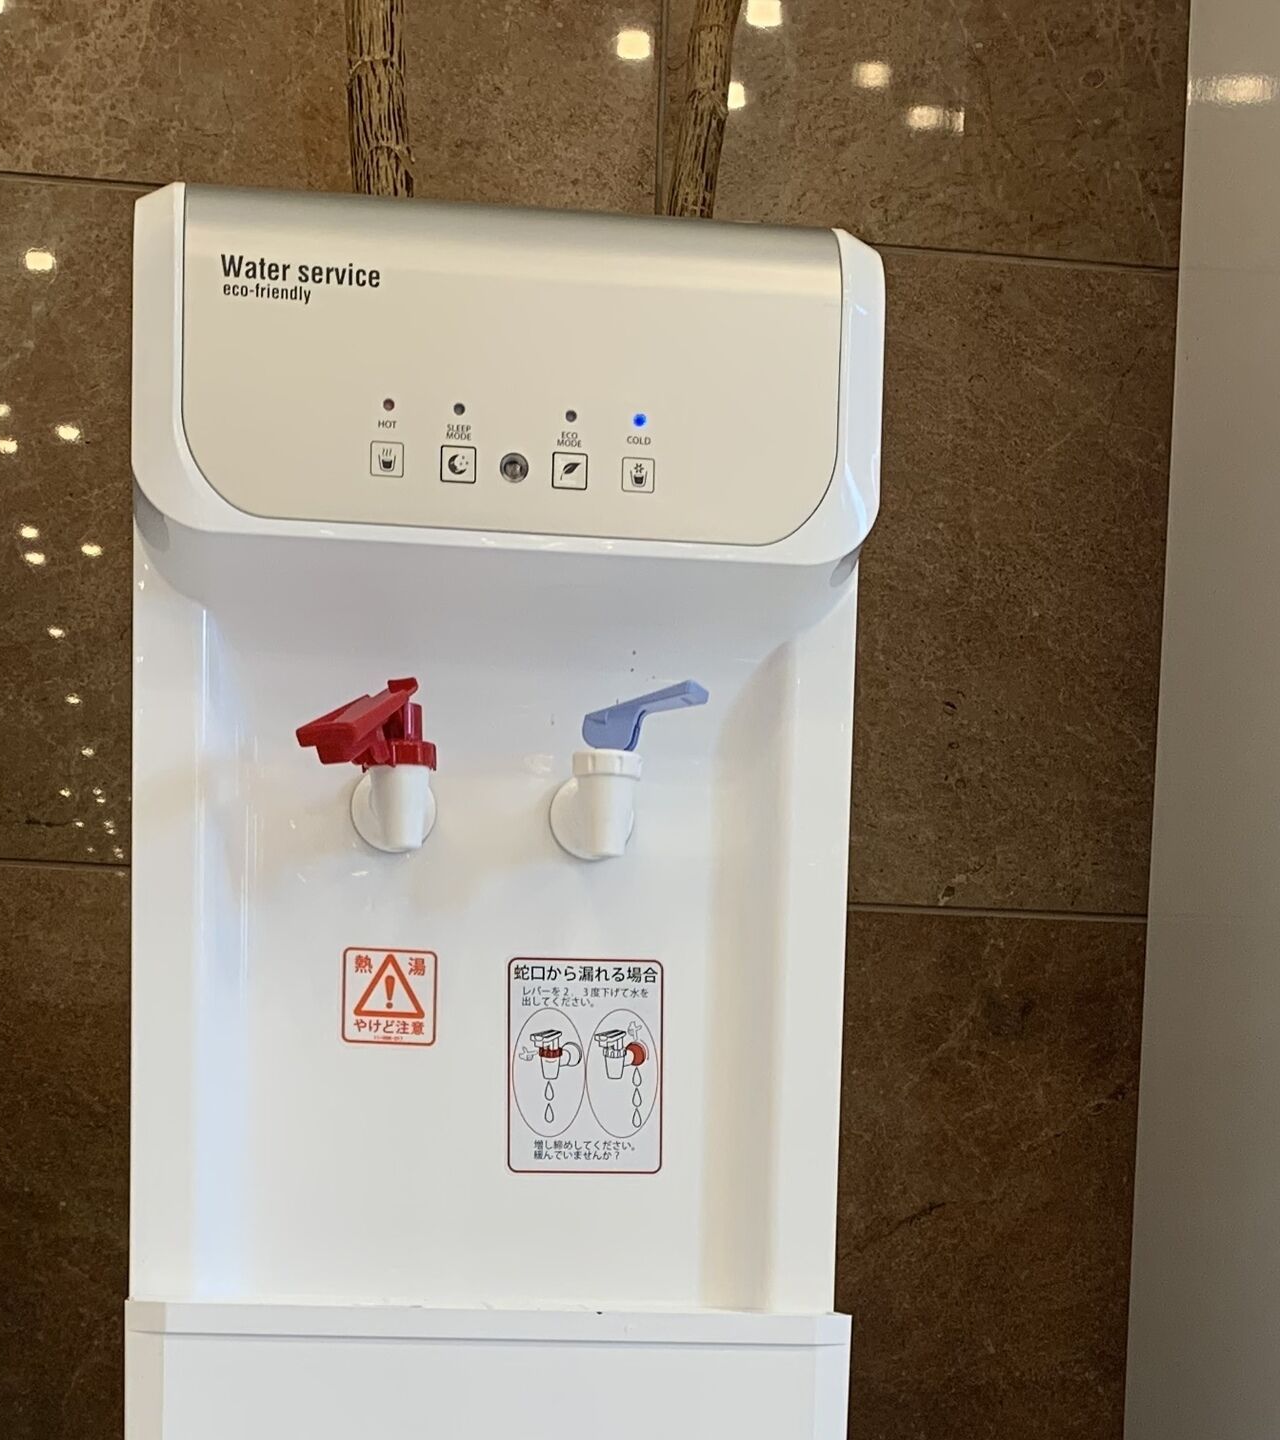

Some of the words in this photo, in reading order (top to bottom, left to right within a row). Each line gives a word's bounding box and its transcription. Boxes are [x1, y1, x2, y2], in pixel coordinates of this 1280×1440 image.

[221, 254, 290, 282] Water
[298, 263, 380, 288] service
[223, 283, 311, 305] eco-friendly
[377, 420, 397, 429] HOT
[446, 424, 472, 433] SLEEP
[446, 432, 472, 440] MODE
[561, 431, 579, 440] ECO
[626, 436, 651, 445] COLD
[556, 439, 582, 448] MODE
[355, 955, 373, 974] 熱
[408, 957, 426, 976] 湯
[513, 964, 658, 984] 蛇口から漏れる場合
[521, 996, 595, 1008] 出してください。
[353, 1019, 425, 1035] やけど注意
[533, 1140, 635, 1151] 増し締めしてください。
